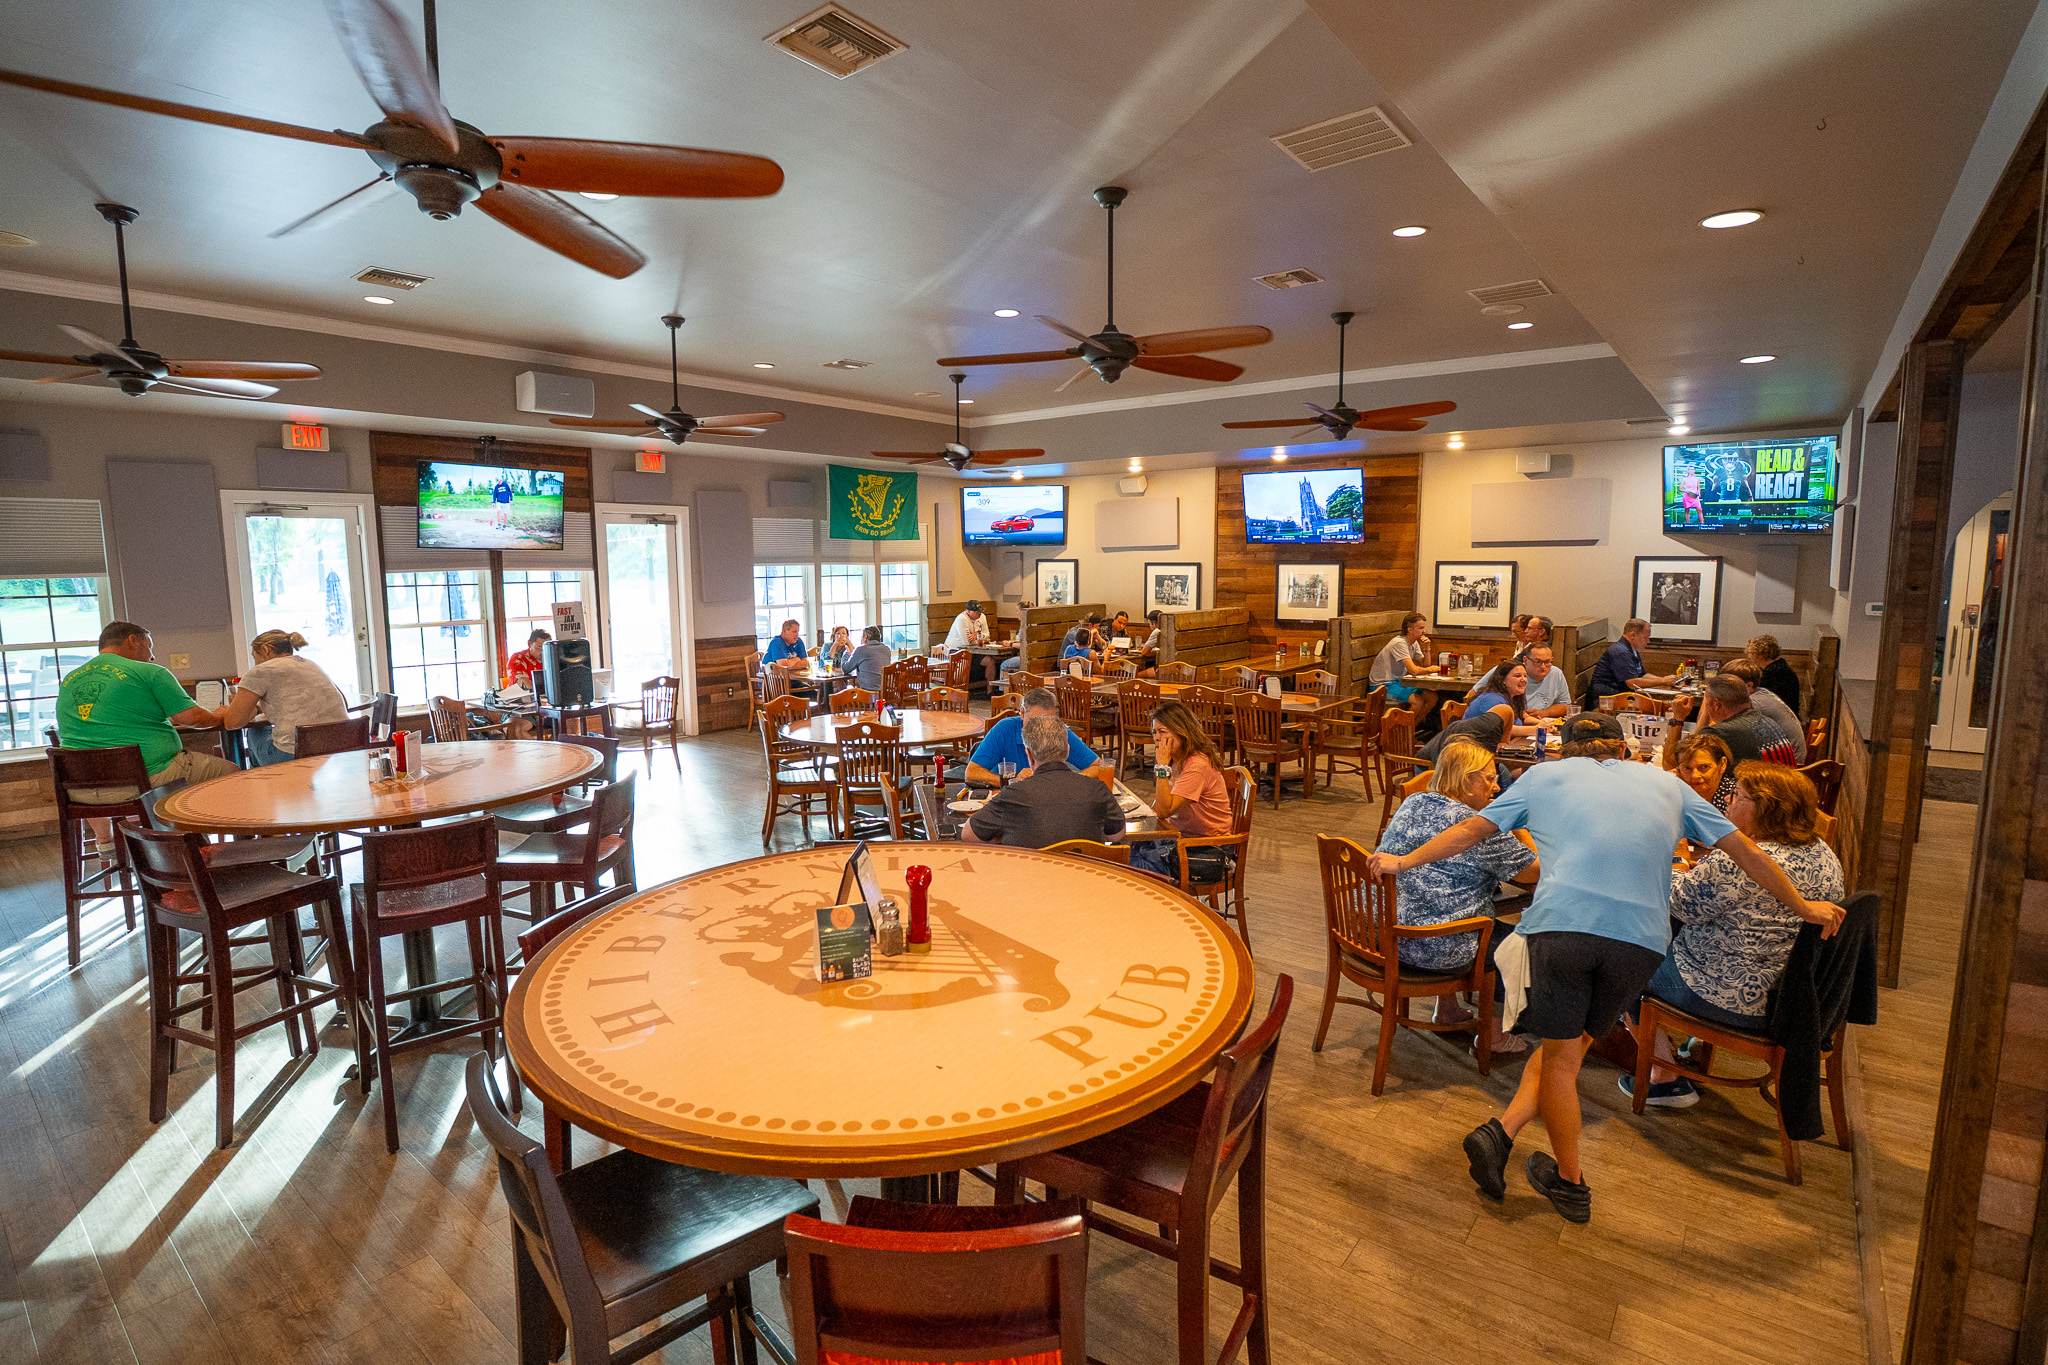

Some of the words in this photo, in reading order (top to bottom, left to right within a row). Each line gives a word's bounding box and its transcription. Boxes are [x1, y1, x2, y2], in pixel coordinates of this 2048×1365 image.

[291, 425, 322, 449] EXIT
[642, 453, 662, 471] EXIT
[1756, 449, 1792, 473] READ
[1792, 447, 1805, 471] &
[1726, 478, 1735, 492] 8
[1754, 472, 1805, 499] REACT
[854, 524, 869, 535] ERIN
[870, 529, 879, 537] GO
[557, 606, 572, 616] FAST
[563, 615, 575, 624] JAX
[560, 622, 581, 632] TRIVIA
[587, 855, 978, 1044] HIBERNIA
[1030, 963, 1191, 1071] PUB
